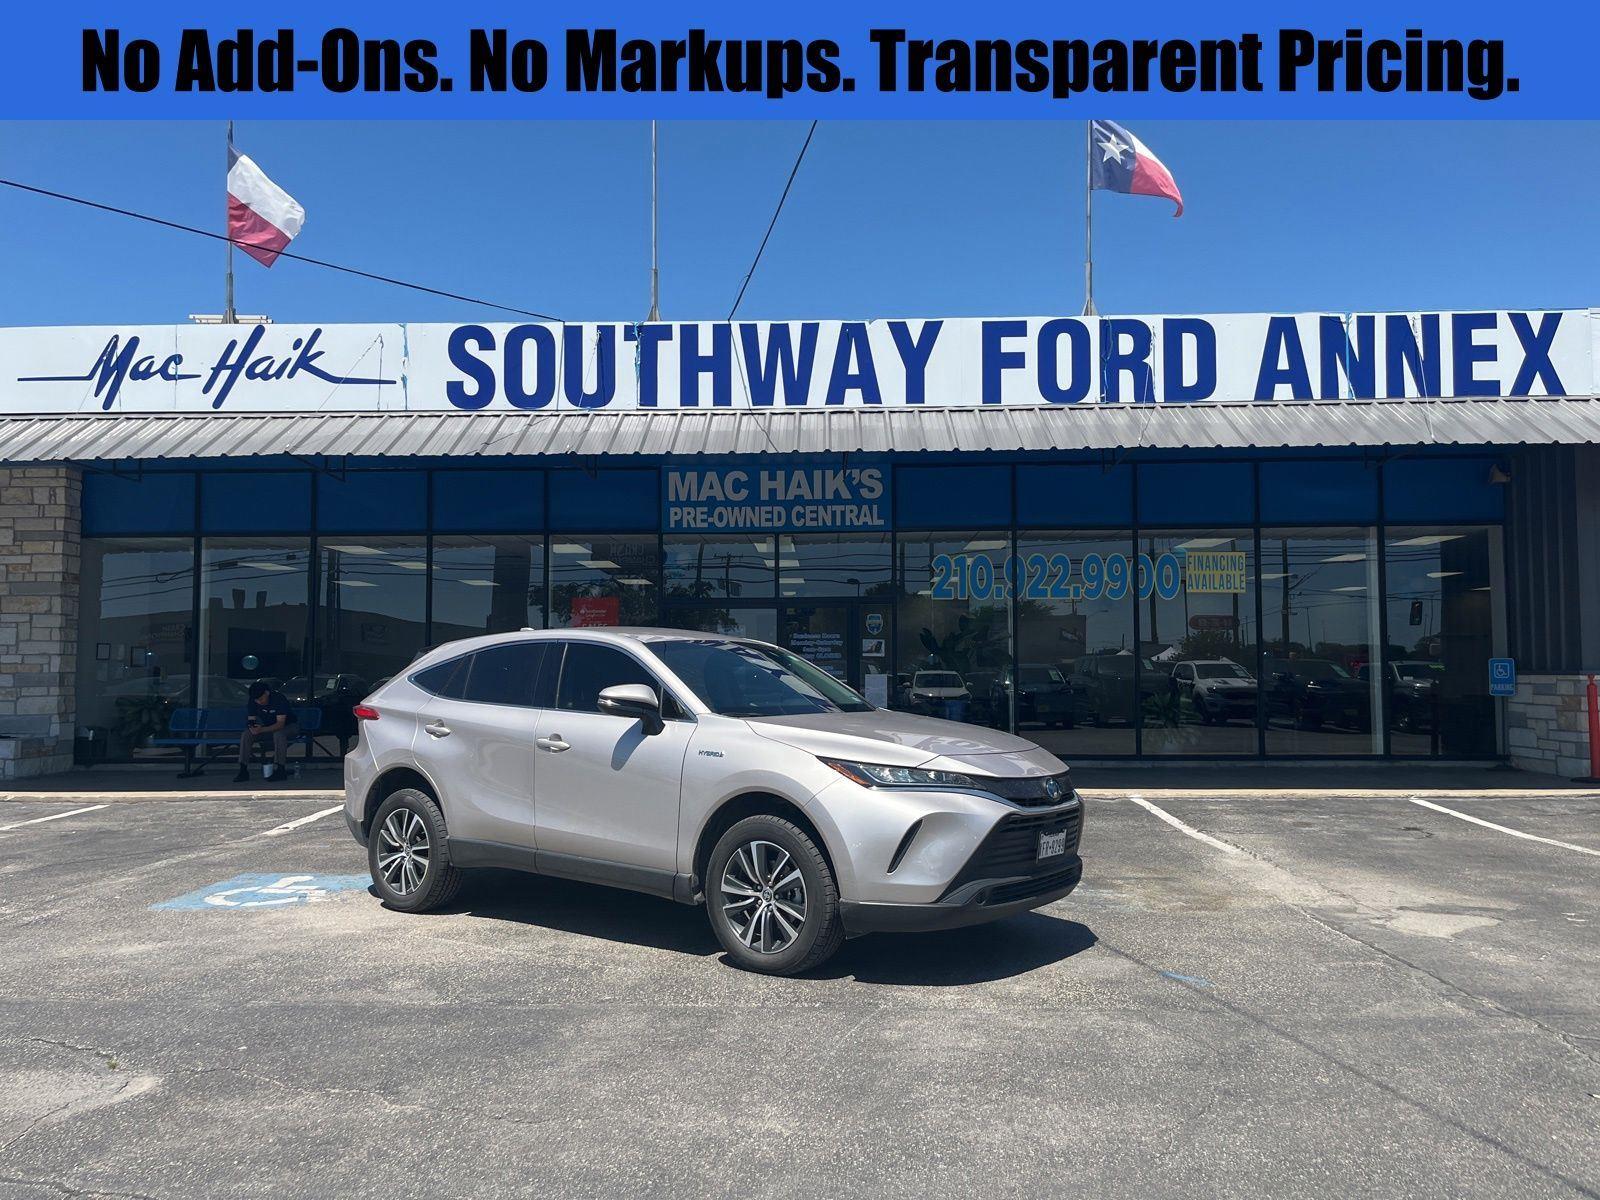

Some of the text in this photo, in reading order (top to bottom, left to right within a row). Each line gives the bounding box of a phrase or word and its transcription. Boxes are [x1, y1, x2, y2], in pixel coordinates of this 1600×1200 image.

[17, 324, 397, 410] Mac Haik
[446, 312, 1567, 409] SOUTHWAY FORD ANNEX
[668, 469, 884, 501] MAC HAIK'S
[669, 504, 885, 528] PRE-OWNED CENTRAL
[931, 552, 1182, 600] 210.922.9900
[1187, 555, 1245, 571] FINANCING
[1187, 573, 1245, 590] AVAILABLE
